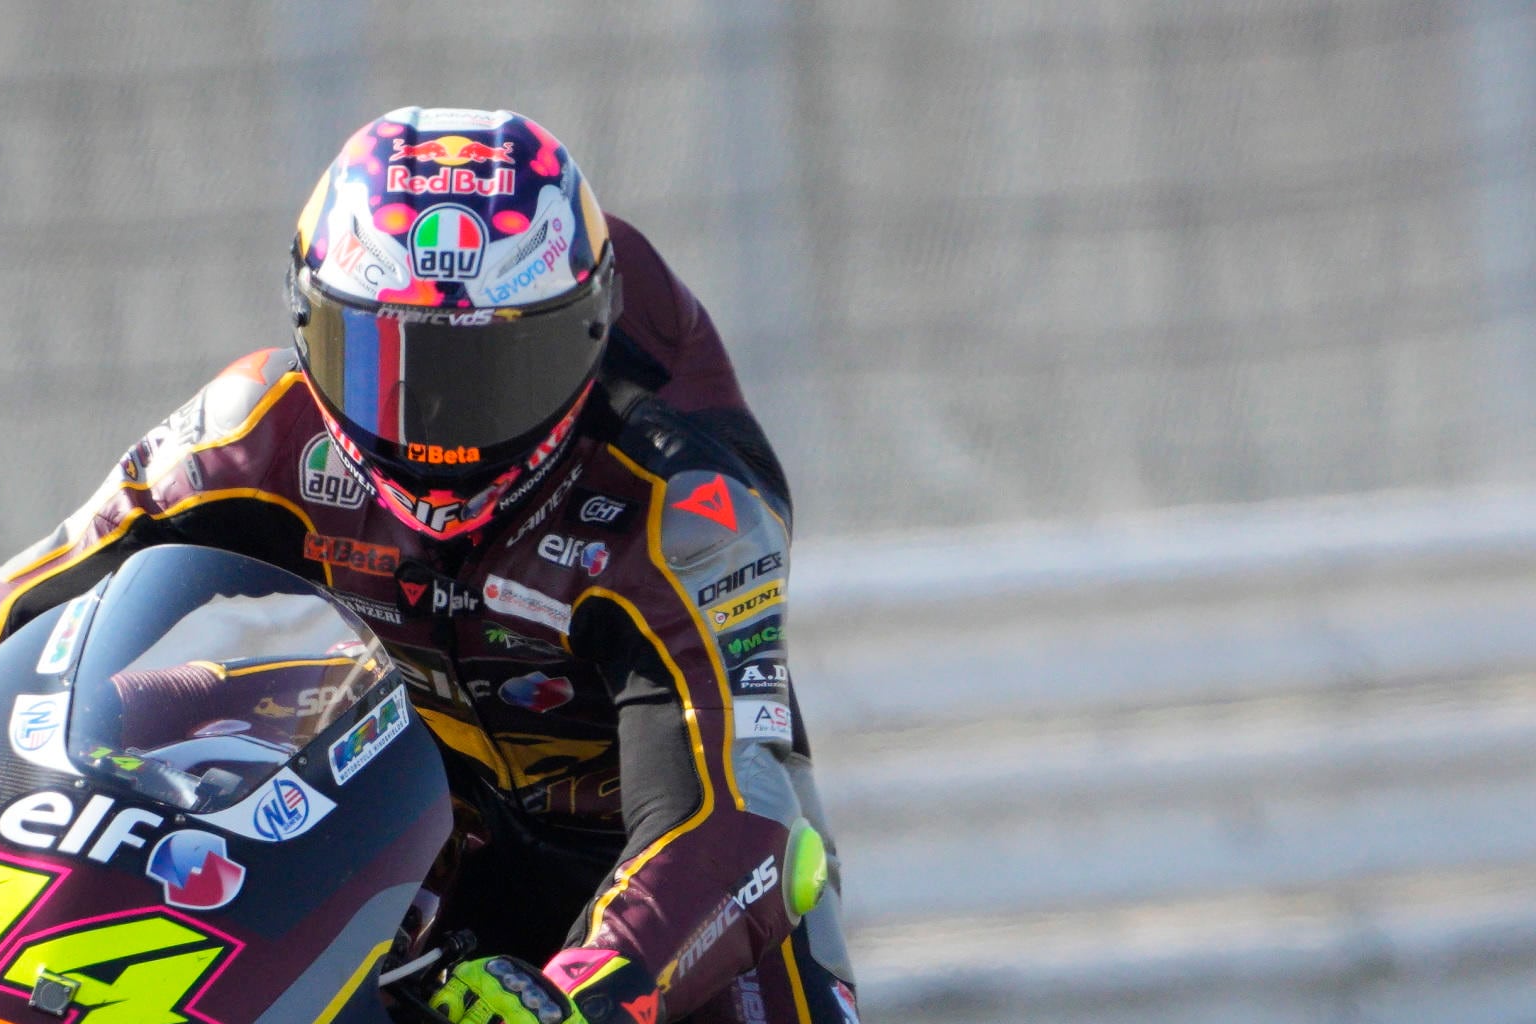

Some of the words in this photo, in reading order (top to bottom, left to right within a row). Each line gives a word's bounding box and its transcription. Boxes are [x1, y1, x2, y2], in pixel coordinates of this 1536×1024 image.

[387, 166, 450, 194] Red
[452, 167, 514, 196] Bull
[420, 250, 476, 280] agv
[428, 445, 480, 464] Beta
[308, 469, 362, 502] agv
[333, 541, 399, 575] Beta
[537, 534, 584, 568] elf
